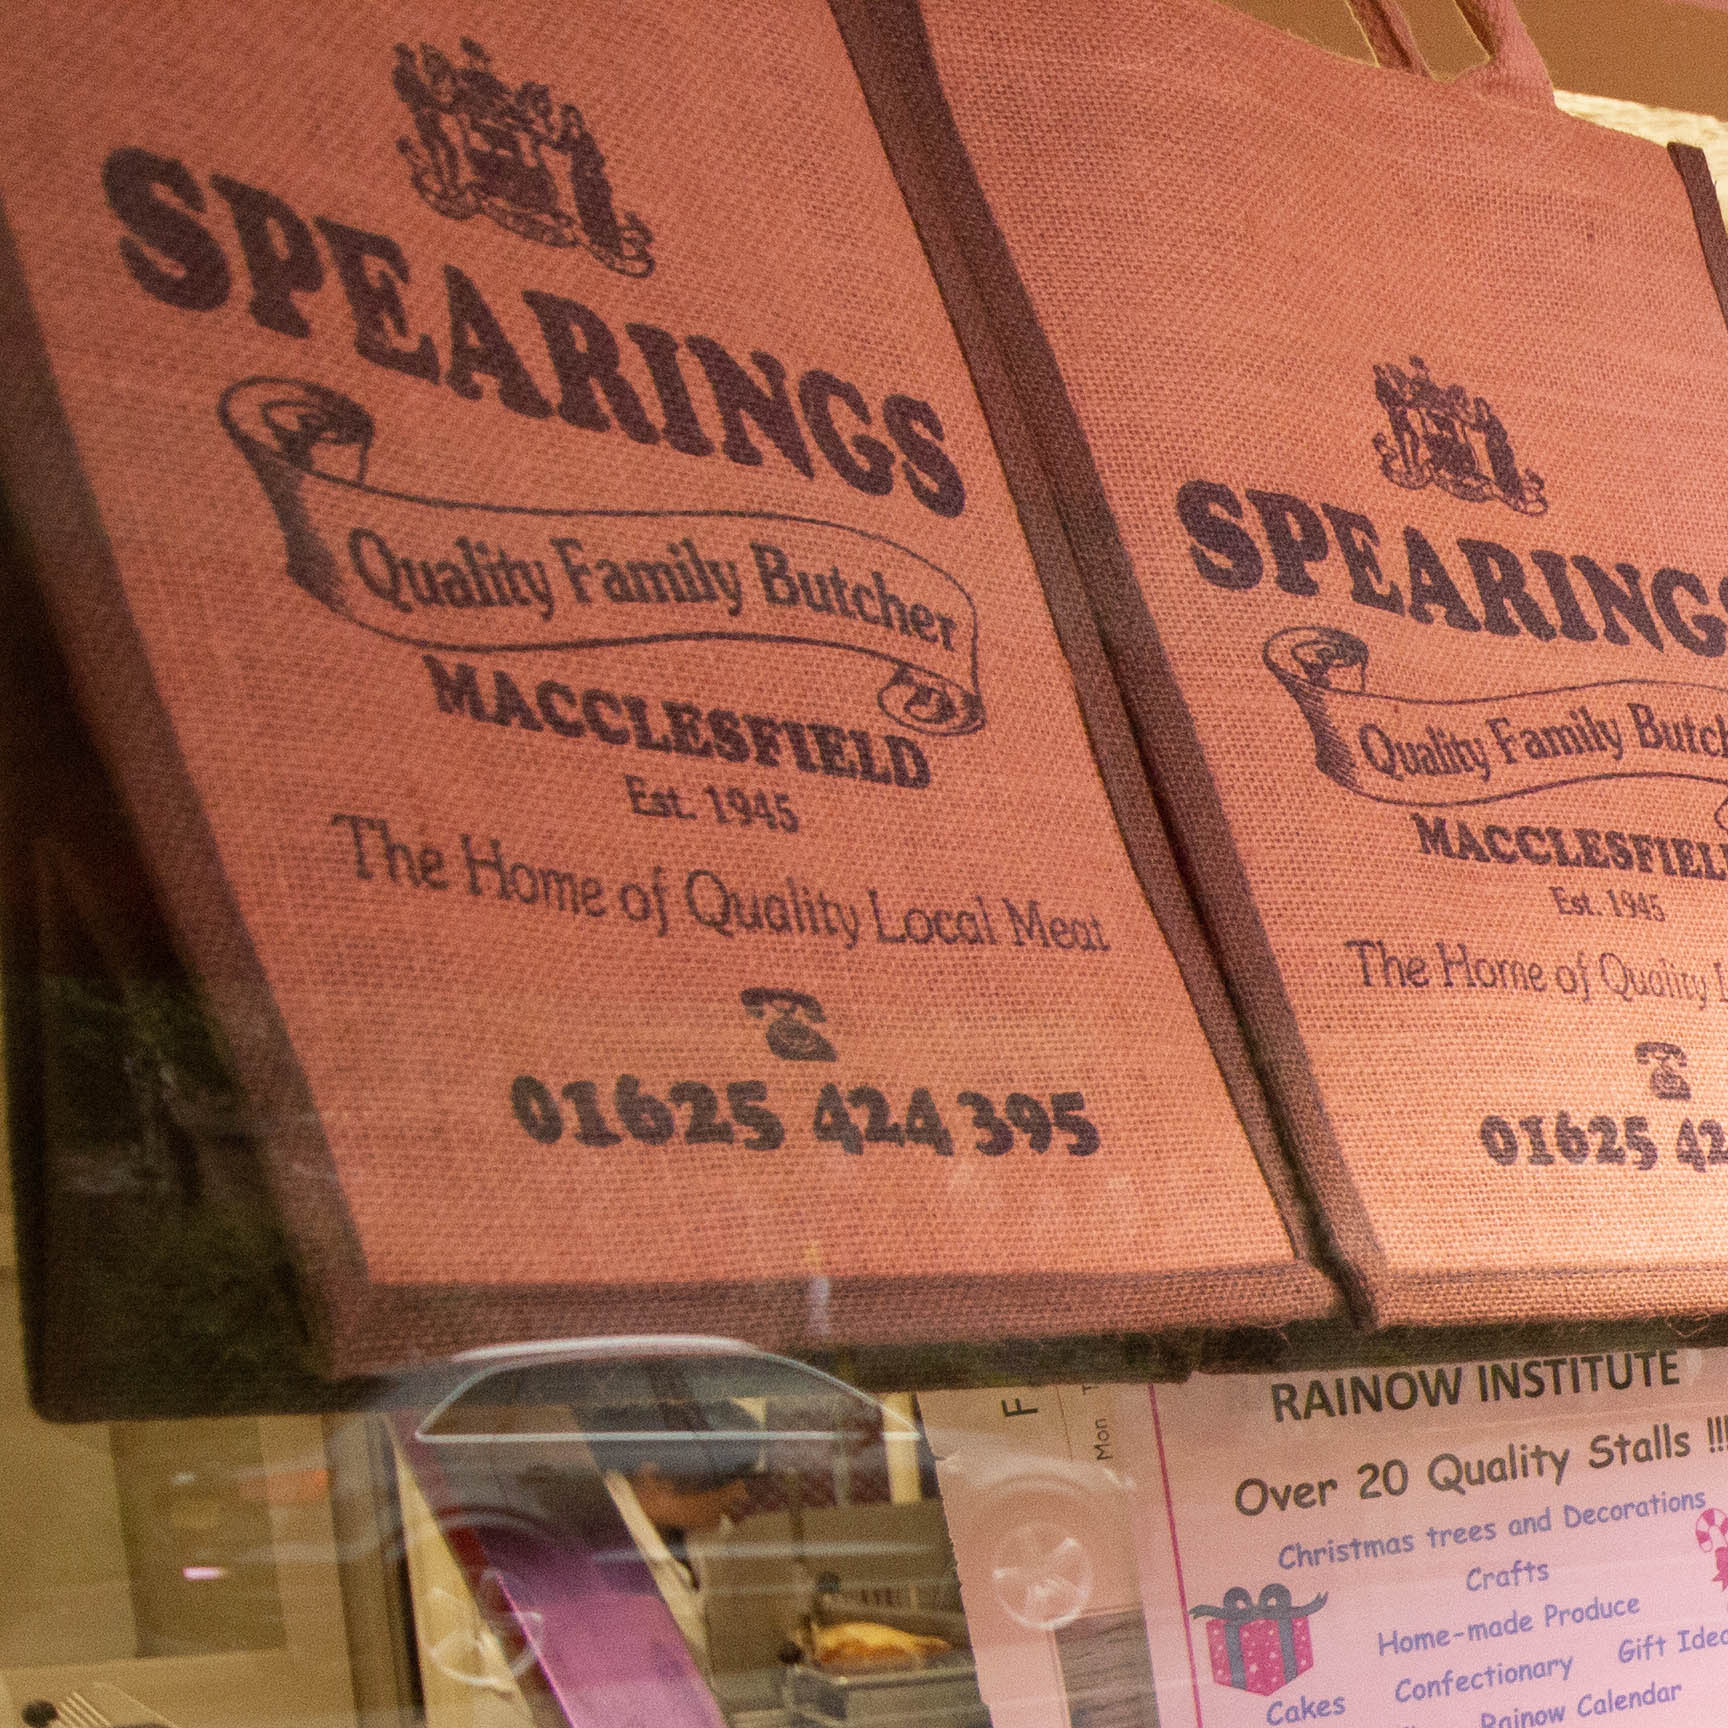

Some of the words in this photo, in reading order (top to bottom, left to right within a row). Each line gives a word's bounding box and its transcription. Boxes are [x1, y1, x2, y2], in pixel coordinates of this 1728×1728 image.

[101, 146, 967, 518] SPEARINGS
[348, 527, 554, 620] Quality
[550, 537, 743, 616] Family
[749, 541, 956, 653] Butcher
[421, 655, 932, 789] MACCLESFIELD
[1359, 720, 1492, 782] Quality
[1489, 710, 1627, 764] Family
[624, 773, 696, 820] Est.
[703, 783, 800, 835] 1945
[331, 812, 449, 891] The
[462, 837, 606, 919] Home
[621, 863, 675, 936] of
[684, 866, 862, 947] Quality
[873, 891, 997, 949] Local
[1012, 899, 1111, 953] Meat
[1550, 885, 1597, 917] Est.
[1607, 888, 1667, 922] 1945
[1347, 939, 1428, 987] The
[1436, 942, 1547, 994] Home
[1555, 955, 1591, 1000] of
[1600, 951, 1708, 1011] Quality
[509, 1074, 786, 1151] 01625
[812, 1084, 954, 1157] 424
[960, 1091, 1100, 1157] 395
[1481, 1112, 1659, 1170] 01625
[1270, 1366, 1463, 1423] RAINOW
[1479, 1349, 1682, 1402] INSTITUTE
[1235, 1475, 1339, 1516] Over
[1357, 1457, 1410, 1501] 20
[1427, 1442, 1571, 1495] Quality
[1588, 1421, 1692, 1470] Stalls
[1278, 1532, 1416, 1571] Christmas
[1426, 1518, 1497, 1548] trees
[1507, 1511, 1553, 1537] and
[1563, 1489, 1707, 1530] Decorations
[1466, 1559, 1550, 1594] Crafts
[1377, 1610, 1534, 1657] Home-made
[1543, 1593, 1641, 1630] Produce
[1395, 1654, 1574, 1704] Confectionary
[1618, 1635, 1671, 1665] Gift
[1577, 1679, 1684, 1719] Calendar
[1265, 1693, 1347, 1727] Cakes
